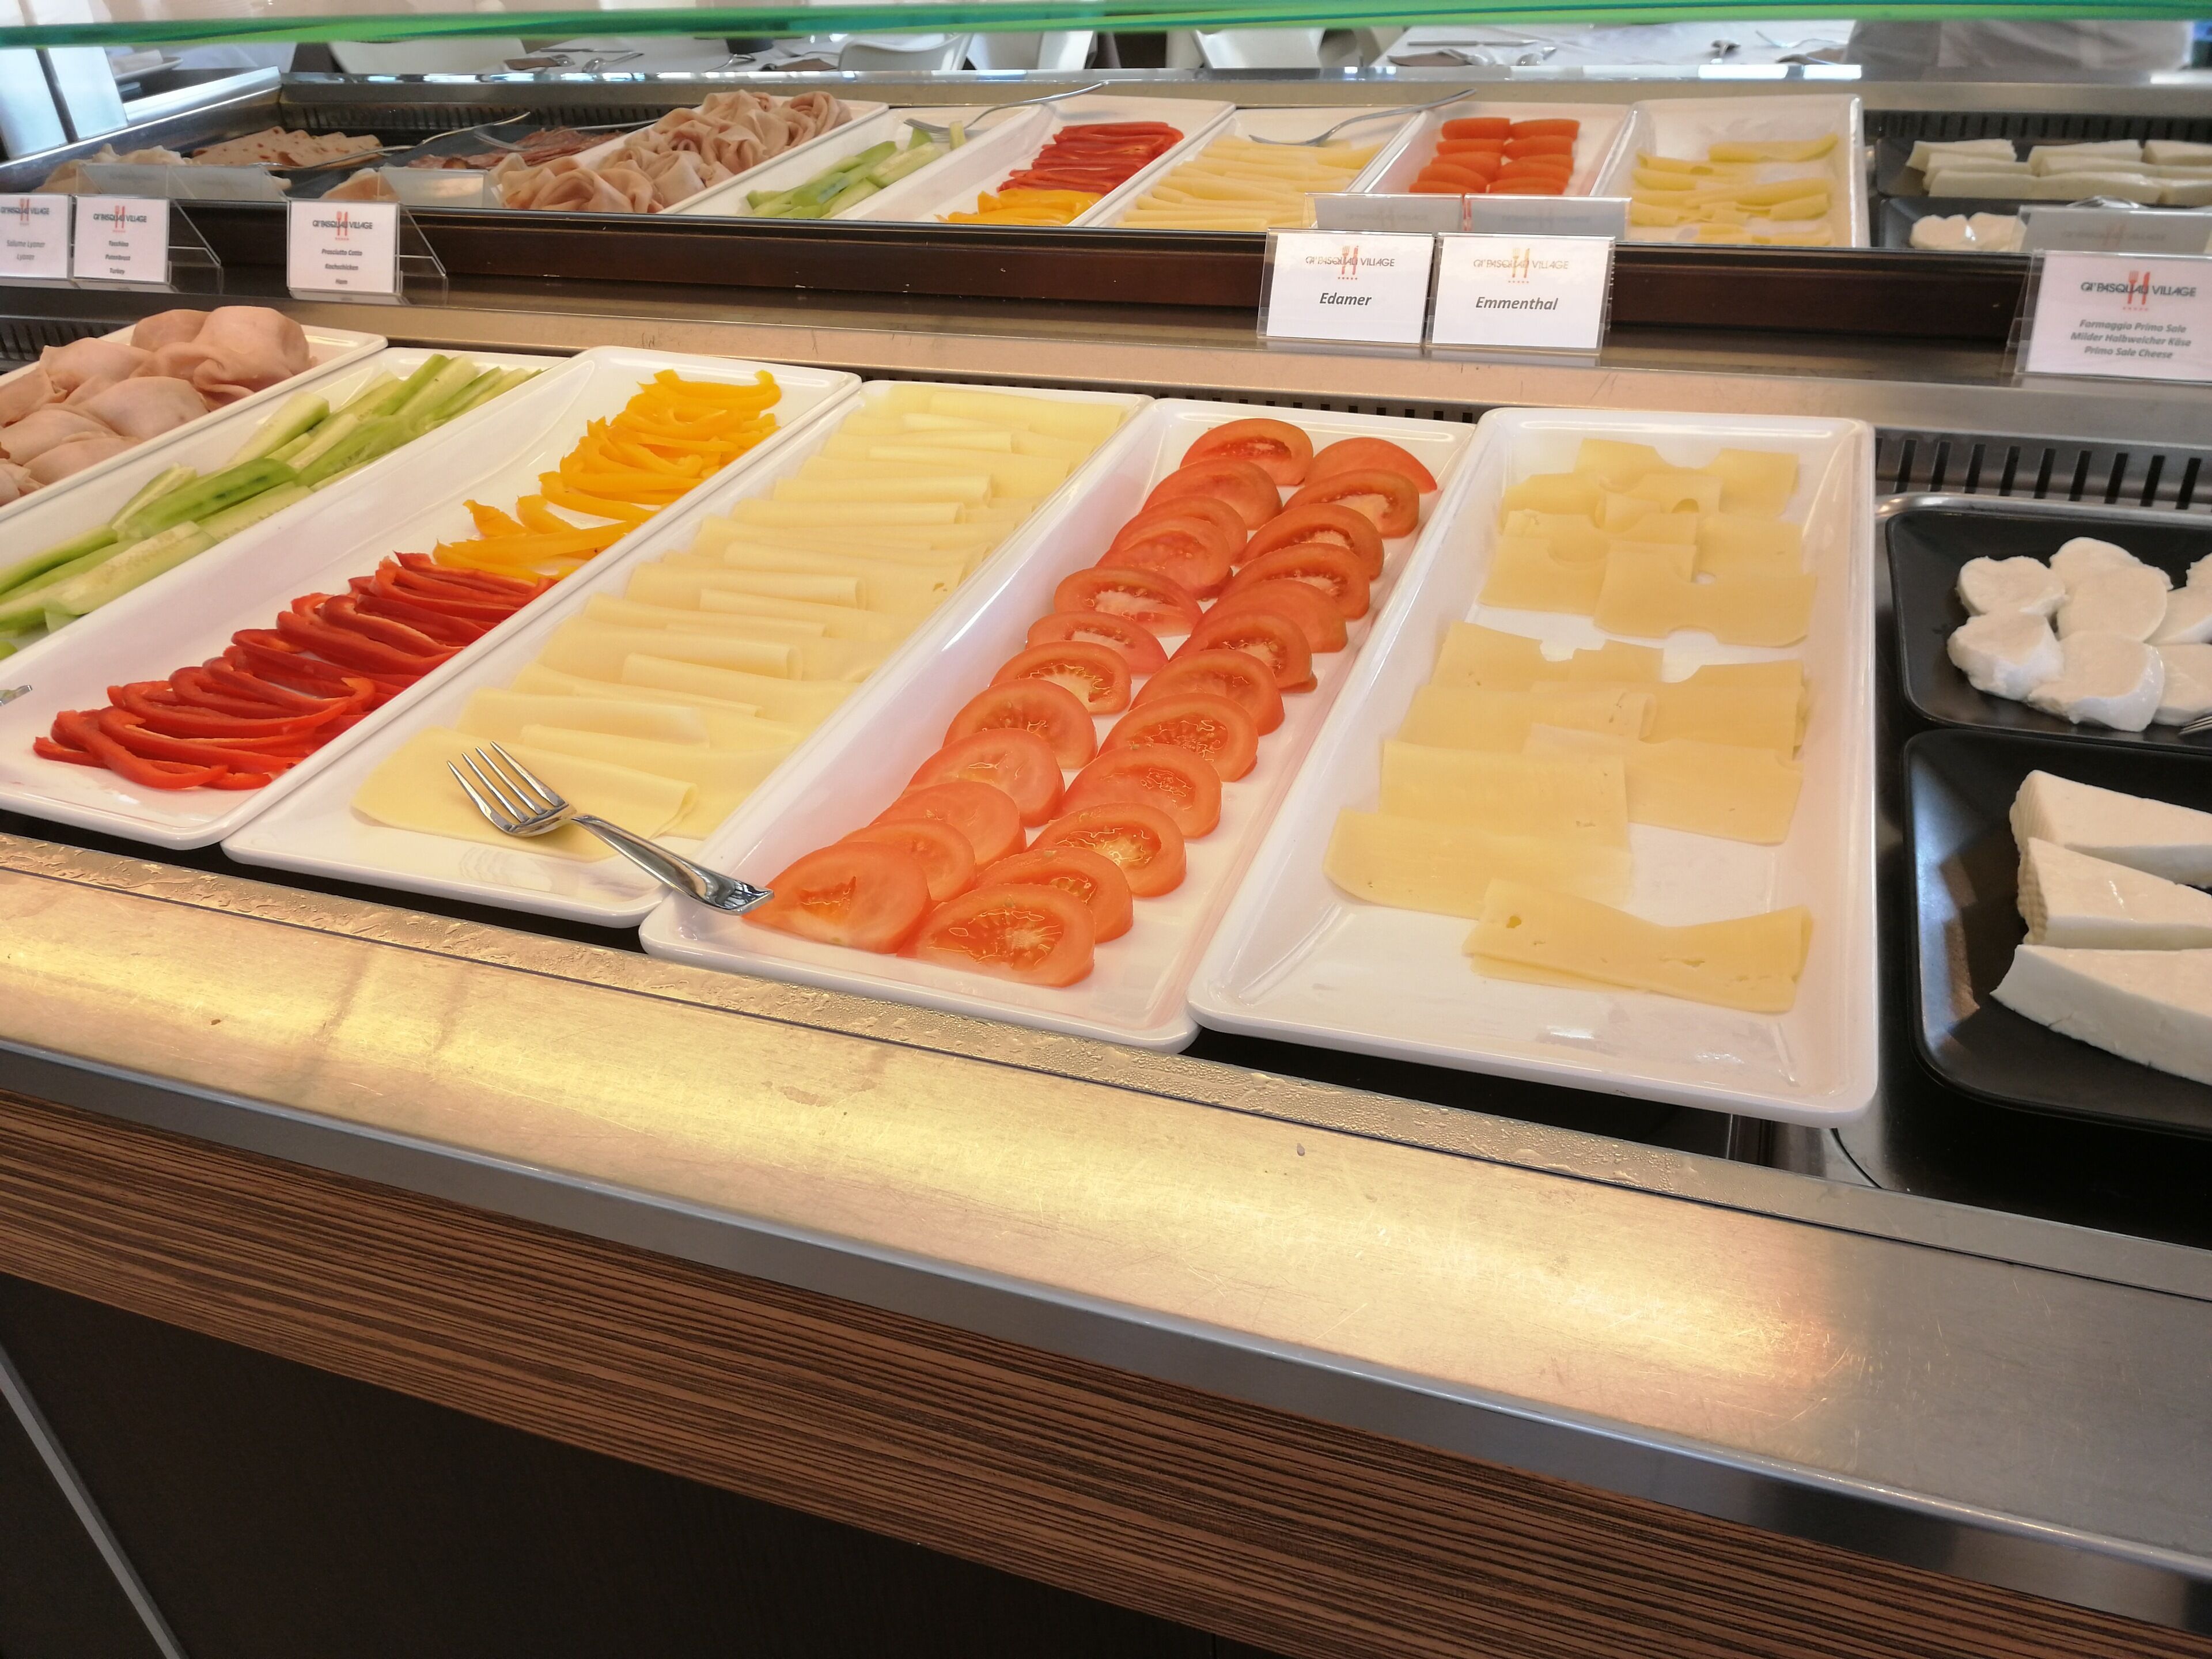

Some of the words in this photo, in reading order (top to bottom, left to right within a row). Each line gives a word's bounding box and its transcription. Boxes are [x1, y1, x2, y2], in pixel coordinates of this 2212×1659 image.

[349, 221, 373, 229] VILLAGE
[1360, 257, 1395, 267] VILLAGE
[1532, 260, 1570, 269] VILLAGE
[2152, 285, 2197, 297] VILLAGE
[1320, 292, 1372, 305] Edamer
[1476, 297, 1559, 310] Emmenthal
[2079, 319, 2133, 331] Formaggio
[2135, 323, 2164, 332] Primo
[2165, 324, 2187, 333] Sale
[2070, 332, 2103, 341] Milder
[2105, 334, 2166, 345] Halbweicher
[2168, 337, 2192, 347] Käse
[2084, 346, 2113, 355] Primo
[2115, 347, 2137, 357] Sale
[2139, 349, 2173, 358] Cheese
